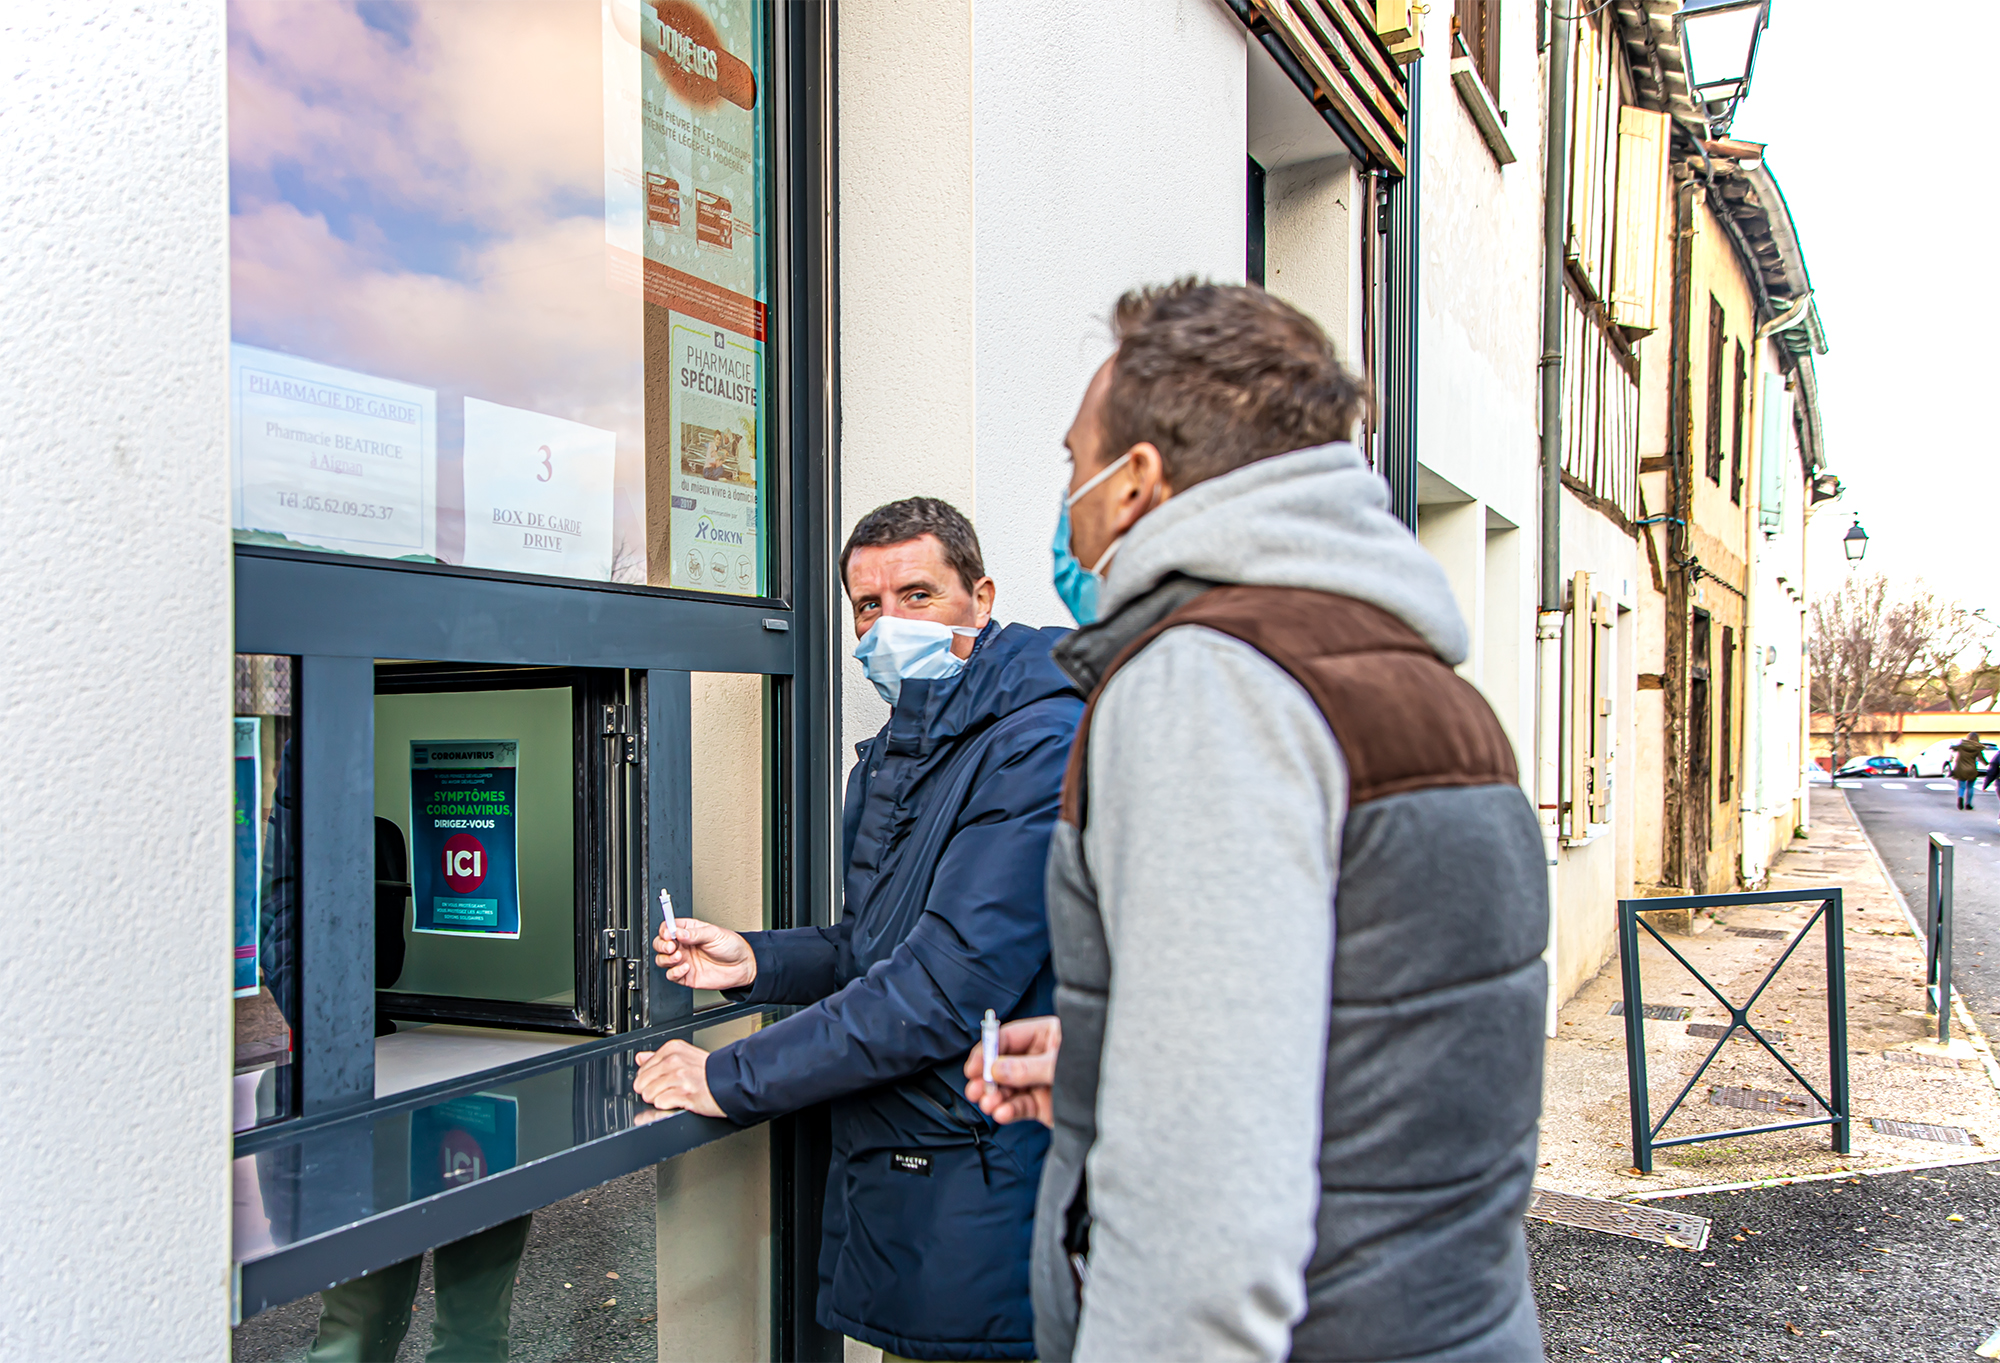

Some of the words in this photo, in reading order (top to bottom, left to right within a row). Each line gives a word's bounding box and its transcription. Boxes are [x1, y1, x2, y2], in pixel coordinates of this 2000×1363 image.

[657, 18, 718, 82] DOULEURS
[654, 105, 664, 119] LA
[665, 110, 691, 133] FIÈVRE
[692, 125, 702, 138] ET
[703, 130, 715, 145] LES
[716, 137, 752, 164] DOULEURS
[687, 345, 752, 383] PHARMACIE
[249, 375, 342, 410] PHARMACIE
[345, 396, 365, 413] DE
[367, 400, 417, 423] GARDE
[681, 367, 757, 407] SPÉCIALISTE
[266, 420, 332, 448] Pharmacie
[335, 433, 403, 460] BEATRICE
[310, 451, 319, 468] à
[320, 453, 363, 476] Aignan
[536, 444, 553, 482] 3
[681, 478, 690, 492] du
[691, 481, 711, 495] mieux
[711, 485, 726, 499] vivre
[727, 487, 732, 500] à
[492, 507, 523, 525] BOX
[526, 511, 545, 528] DE
[547, 515, 582, 535] GARDE
[523, 532, 562, 551] DRIVE
[710, 527, 743, 545] ORKYN
[431, 751, 495, 761] CORONAVIRUS
[434, 788, 505, 802] SYMPTÔMES
[426, 804, 513, 817] CORONAVIRUS,
[434, 819, 495, 829] DIRIGEZ-VOUS
[446, 850, 481, 877] ICI
